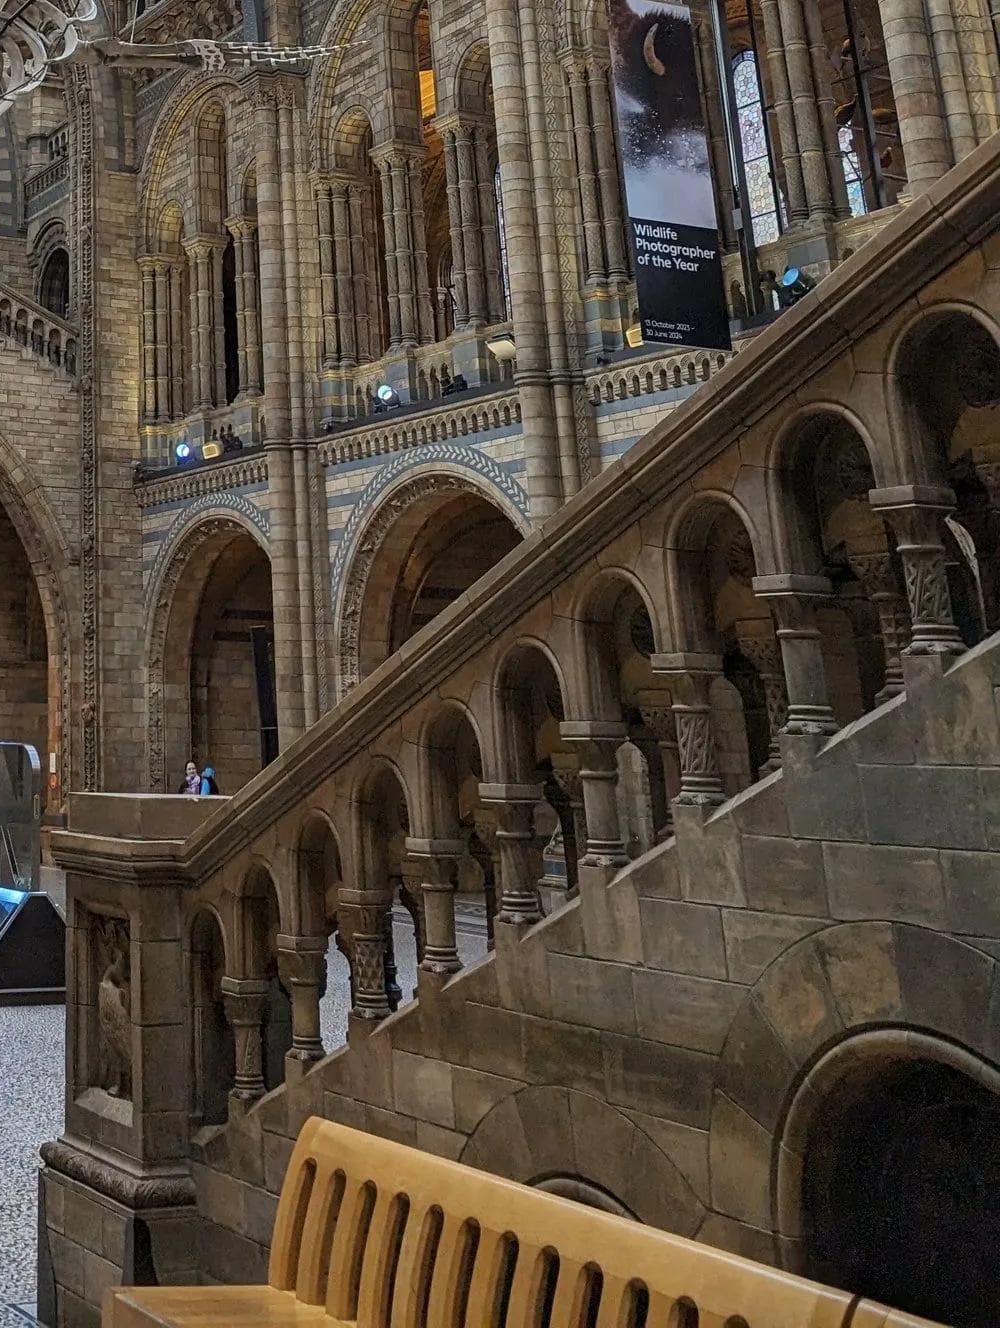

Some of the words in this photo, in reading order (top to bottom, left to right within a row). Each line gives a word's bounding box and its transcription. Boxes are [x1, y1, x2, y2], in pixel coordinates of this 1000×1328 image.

[633, 223, 678, 240] Wildlife
[635, 237, 716, 260] Photographer
[637, 253, 650, 265] of
[652, 255, 672, 268] the
[672, 258, 699, 272] Year
[651, 320, 676, 330] October
[676, 323, 690, 332] 2023
[654, 330, 668, 338] June
[668, 331, 683, 340] 2024
